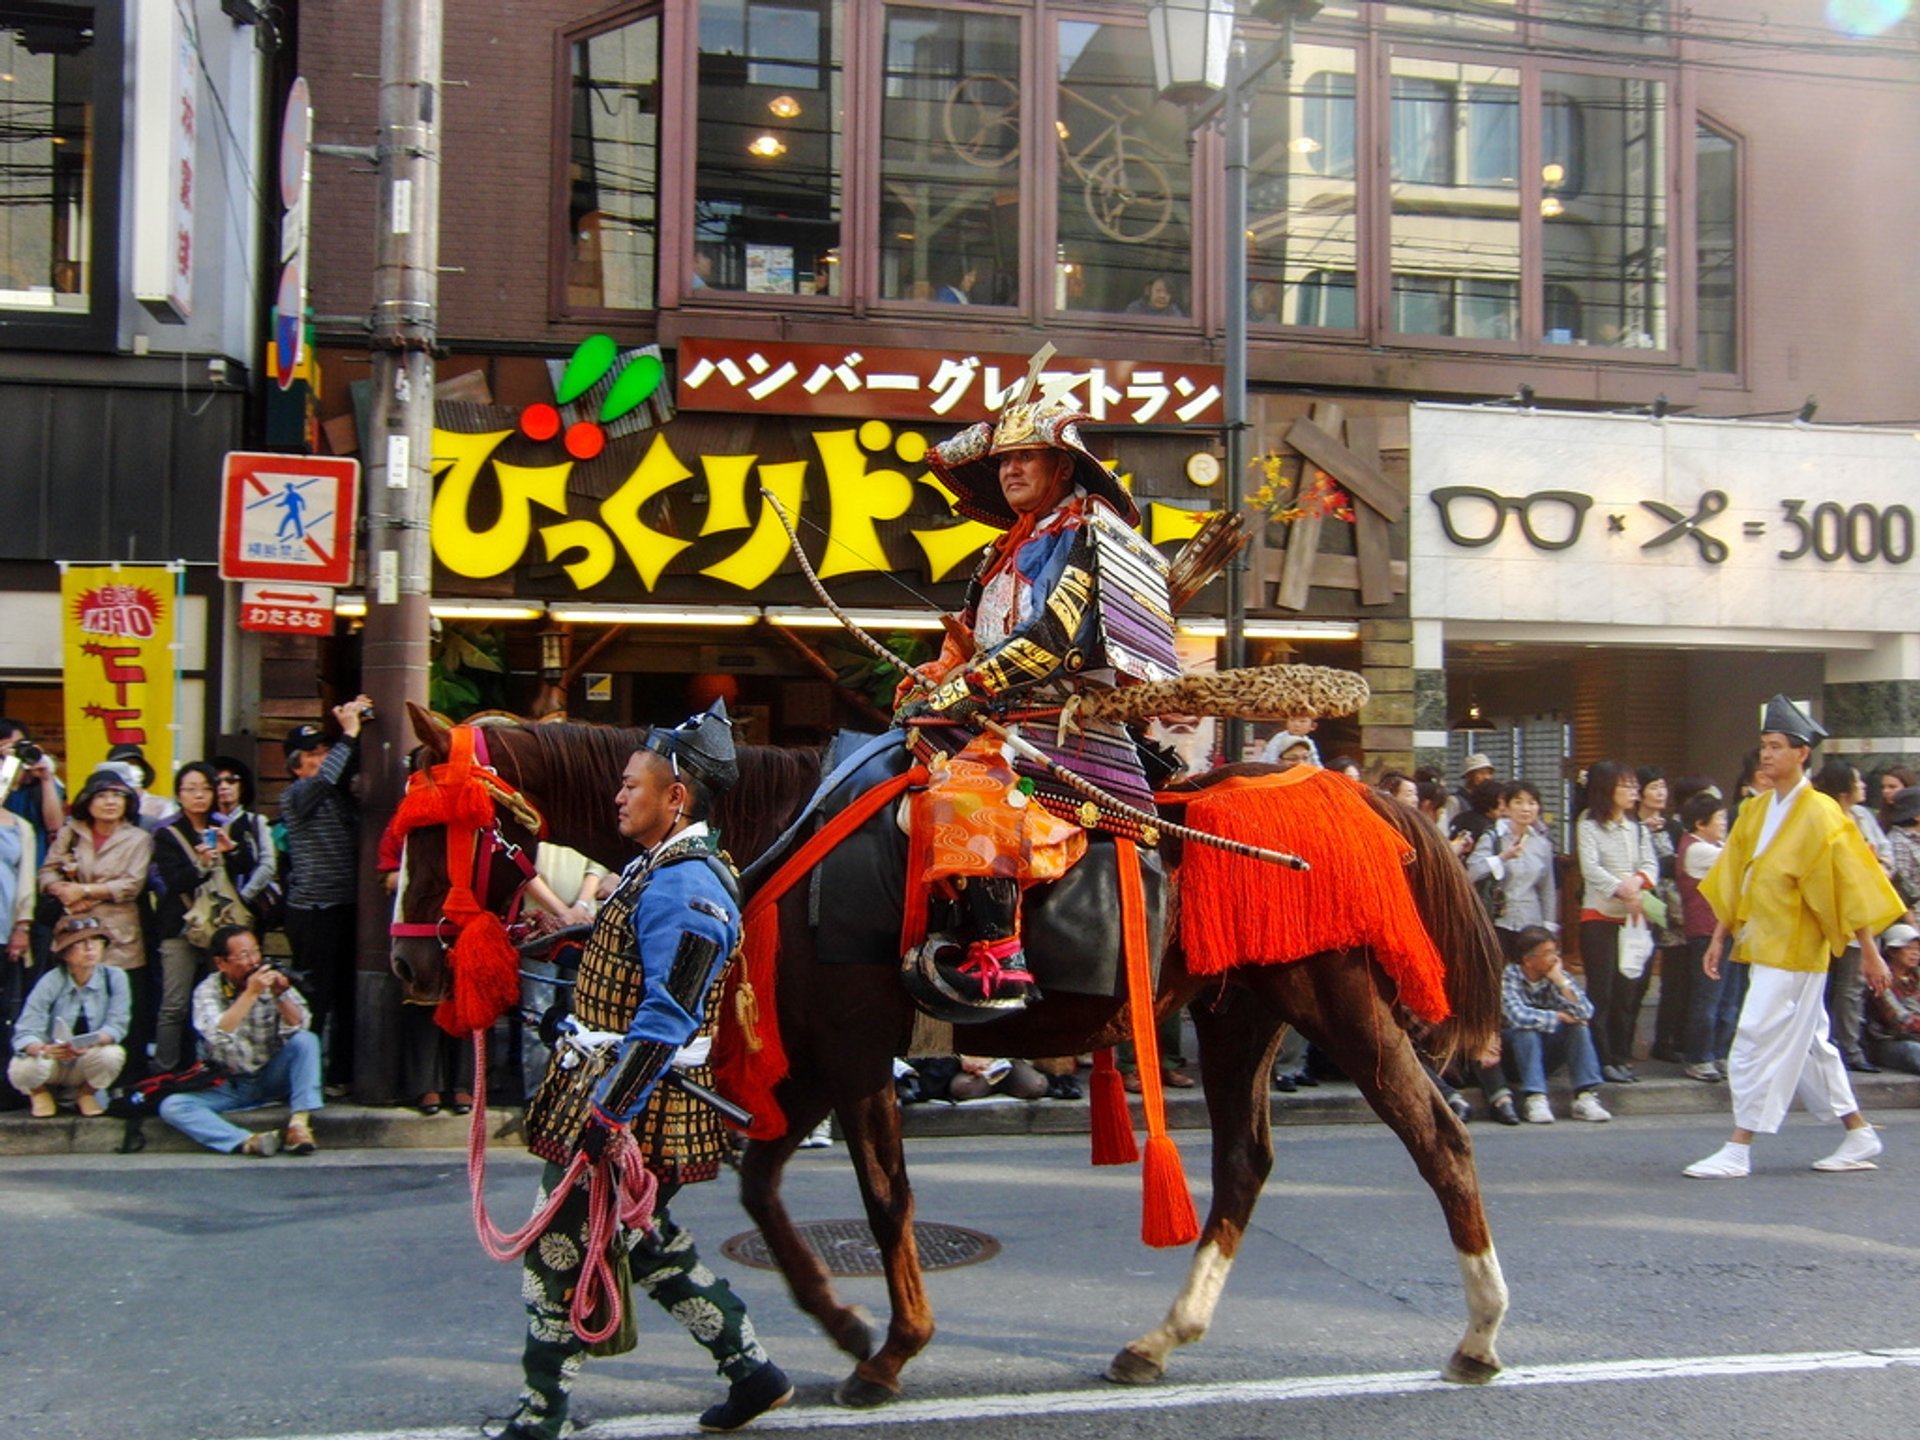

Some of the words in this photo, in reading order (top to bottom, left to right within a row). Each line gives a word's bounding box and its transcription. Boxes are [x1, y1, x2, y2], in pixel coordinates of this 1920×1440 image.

[682, 351, 1222, 424] ハンバーグレストラン
[431, 403, 1224, 593] びっくりドンー
[247, 542, 309, 562] 横断禁止
[1777, 499, 1914, 565] 3000
[248, 606, 324, 629] わたるな
